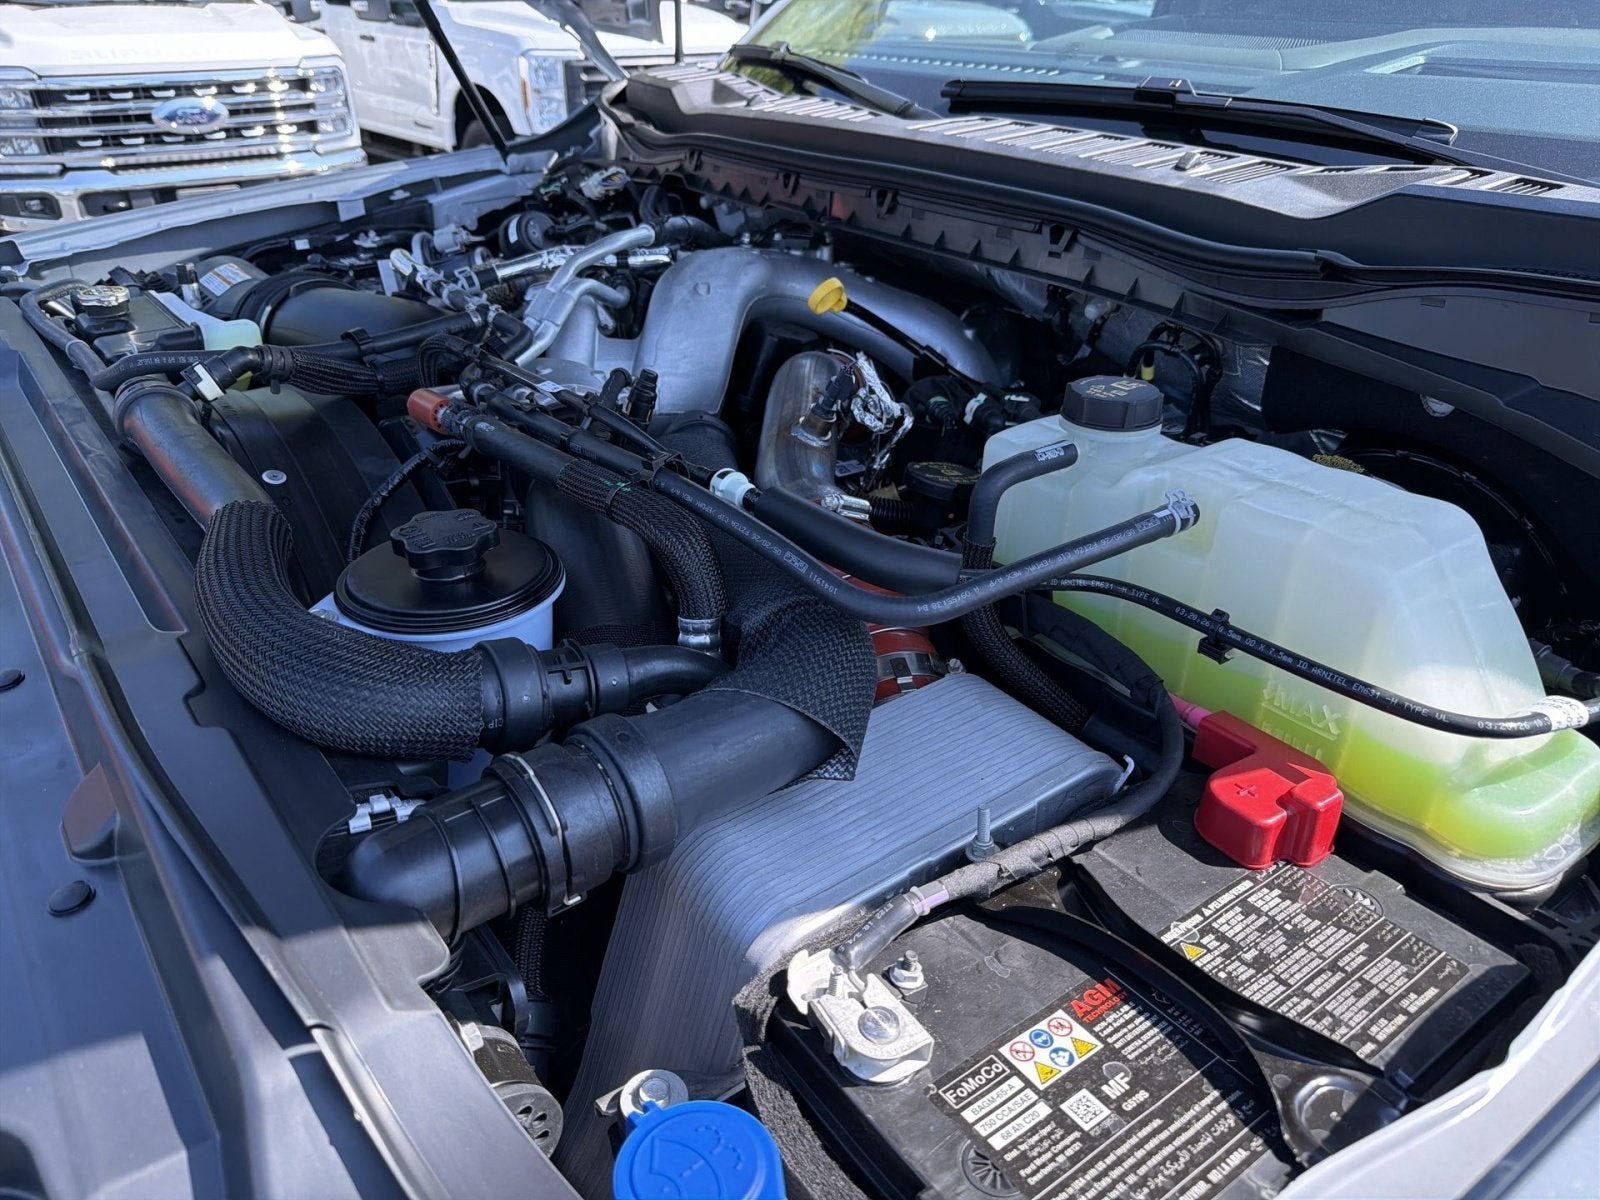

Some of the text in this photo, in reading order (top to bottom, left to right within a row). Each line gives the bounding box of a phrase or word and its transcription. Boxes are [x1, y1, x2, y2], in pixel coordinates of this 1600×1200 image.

[1060, 575, 1088, 588] ARNITEL
[1130, 588, 1150, 600] TYPE
[1258, 643, 1266, 651] X
[1296, 659, 1308, 669] ID
[1309, 665, 1349, 686] ARNITEL
[1402, 701, 1429, 716] TYPE
[1434, 711, 1450, 723] UL
[1065, 976, 1122, 1017] AGM
[1081, 990, 1129, 1024] TECHNOLOGY
[1397, 991, 1419, 1008] LEA LAS
[1098, 1024, 1114, 1037] Lead
[1111, 1016, 1126, 1028] Acid
[1375, 1017, 1390, 1027] LES
[1120, 1038, 1143, 1055] CONTRA
[944, 1059, 1004, 1104] FoMoCo
[1100, 1070, 1135, 1100] MF
[970, 1082, 1016, 1116] BAGM-65-A
[979, 1091, 1034, 1132] 750 CCA/SAE
[1120, 1088, 1151, 1112] G519S
[999, 1109, 1040, 1141] 68 Ah C20
[1206, 1110, 1240, 1139] الولايات
[1018, 1128, 1083, 1178] Ford Motor Company,
[1185, 1129, 1217, 1157] المتحدة
[1223, 1144, 1251, 1168] ABRA.
[1026, 1158, 1060, 1186] Dearborn,
[1063, 1140, 1083, 1157] 48121
[1071, 1175, 1087, 1191] USA
[1082, 1166, 1099, 1182] with
[1094, 1159, 1108, 1172] US
[1102, 1152, 1117, 1166] and
[1112, 1134, 1141, 1158] imported
[1204, 1168, 1222, 1184] NO
[1215, 1159, 1232, 1175] LA
